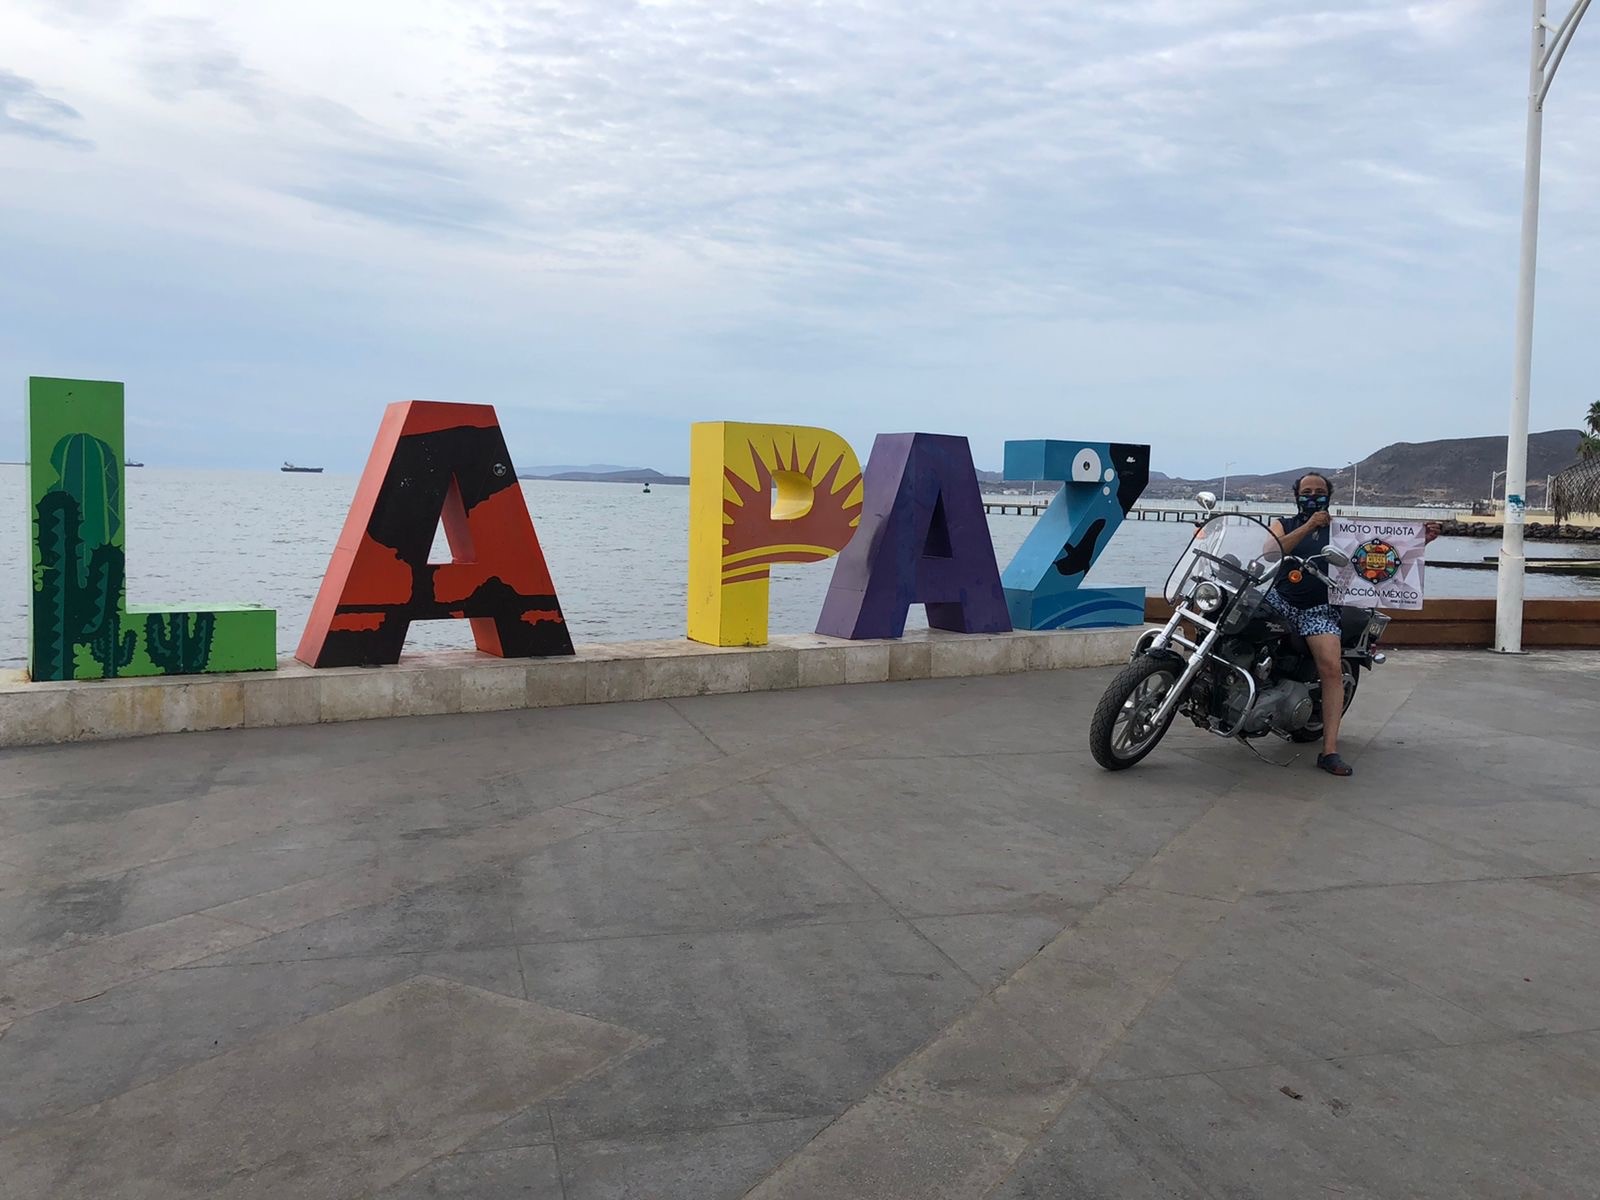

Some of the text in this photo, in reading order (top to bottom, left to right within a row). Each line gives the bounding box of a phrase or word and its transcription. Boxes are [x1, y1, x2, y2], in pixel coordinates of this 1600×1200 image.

[27, 376, 1150, 682] LA PAZ
[1339, 524, 1414, 535] MOTO TURISTA
[1345, 587, 1380, 596] ACCIÓN
[1382, 589, 1418, 599] MÉXICO
